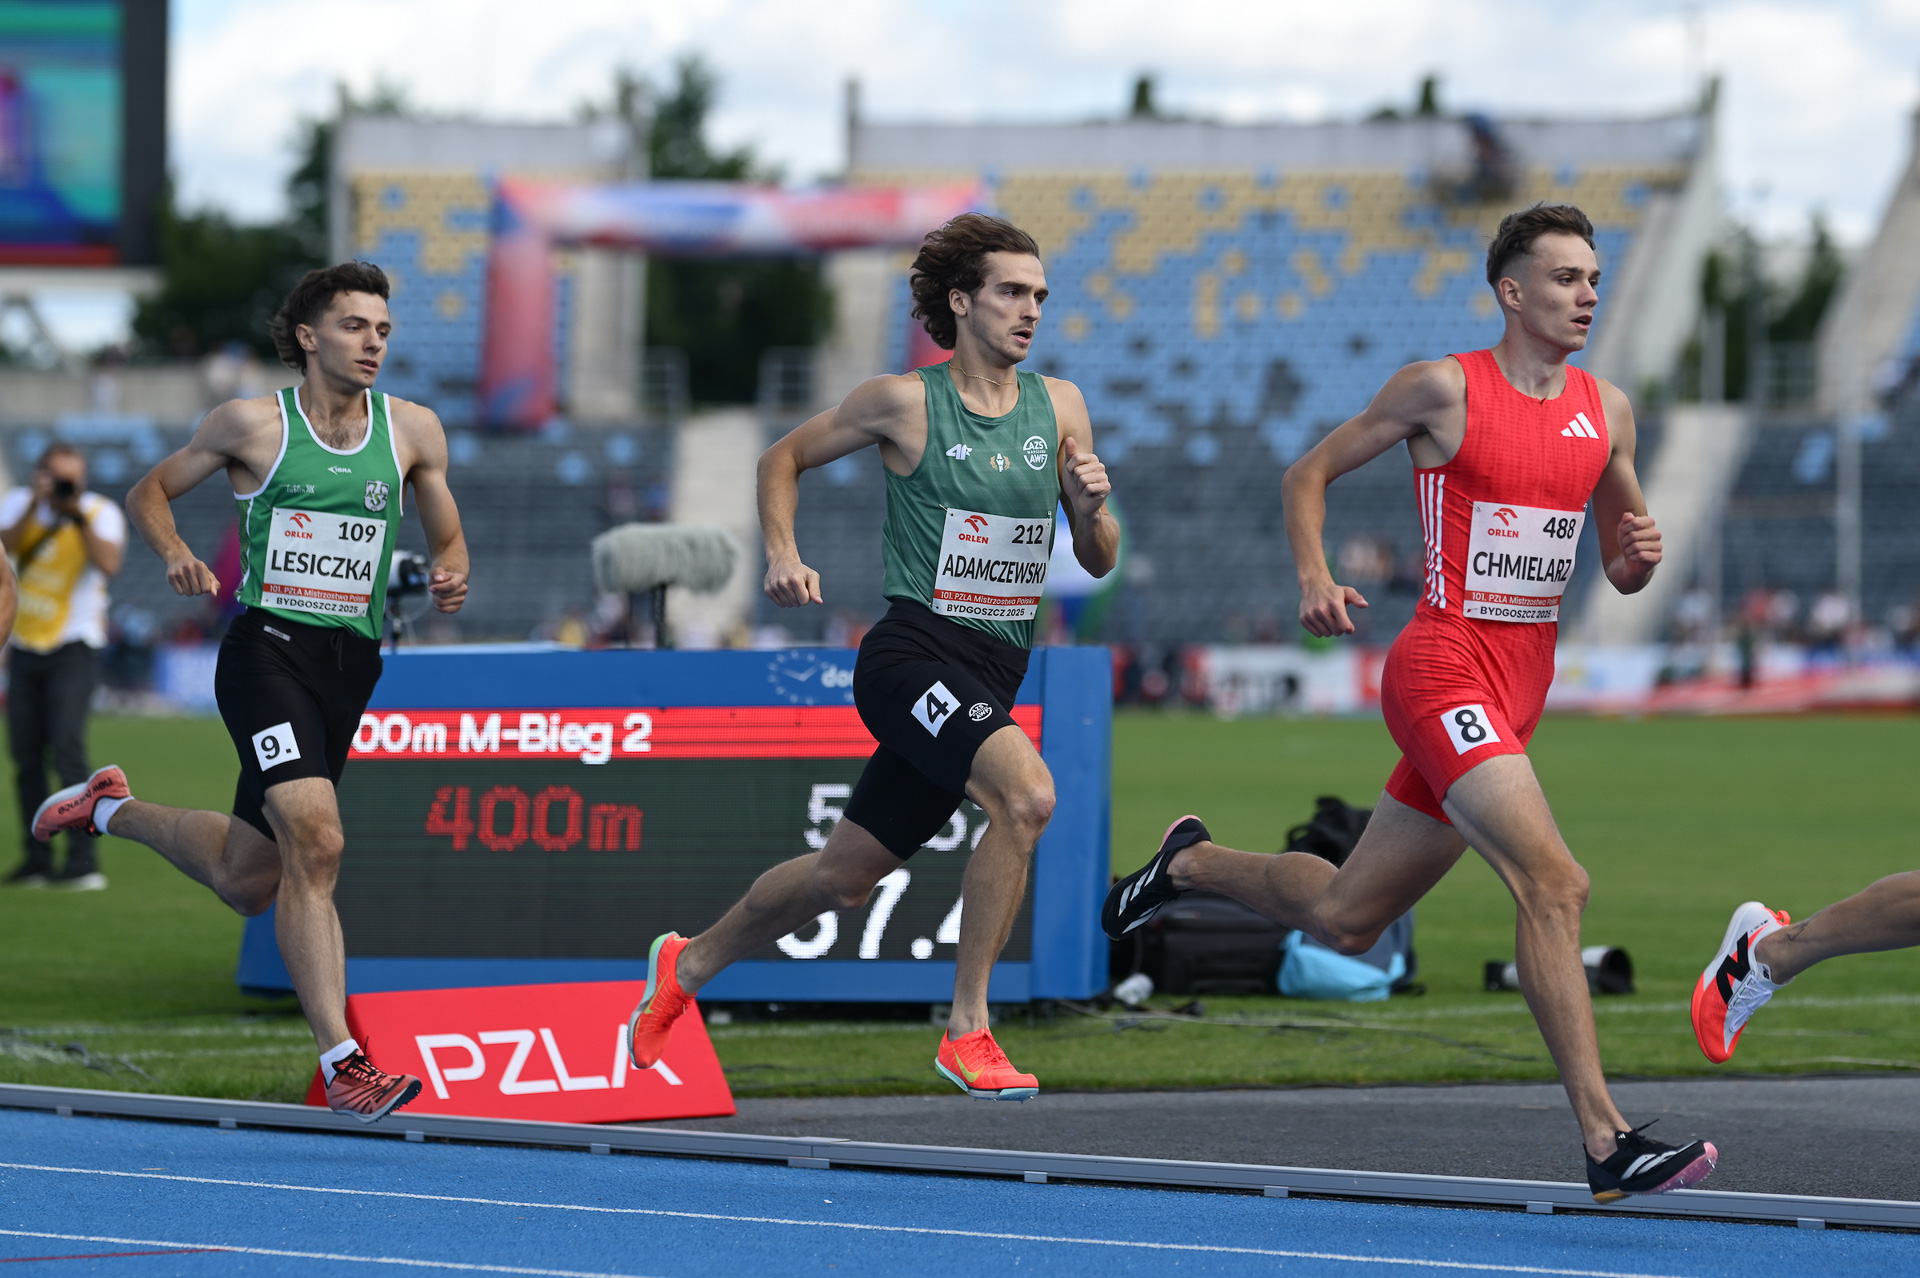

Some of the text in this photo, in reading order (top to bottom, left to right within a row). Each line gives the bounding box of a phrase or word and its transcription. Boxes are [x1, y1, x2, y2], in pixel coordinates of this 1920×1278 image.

[1029, 441, 1044, 450] AZS
[1030, 454, 1045, 463] AWF
[284, 530, 313, 540] ORLEN
[338, 521, 376, 543] 109
[958, 533, 989, 544] ORLEN
[1011, 524, 1044, 545] 212
[1487, 528, 1519, 539] ORLEN
[1543, 517, 1577, 539] 488
[271, 549, 371, 582] LESICZKA
[942, 553, 1047, 584] ADAMCZEWSKI
[1473, 551, 1572, 582] CHMIELARZ
[269, 585, 367, 603] 101. PZLA Mistrzostwa Polski
[940, 591, 1035, 605] 101. PZLA Mistrzostwa Polski
[1472, 592, 1487, 602] 101.
[1488, 594, 1508, 603] PZLA
[1509, 596, 1546, 606] Mistrzostwa
[276, 597, 358, 613] BYDGOSZCZ 2025
[946, 604, 1025, 617] BYDGOSZCZ 2025
[1480, 606, 1552, 618] BYDGOSZCZ 2025
[926, 691, 950, 724] 4
[1455, 709, 1487, 743] 8
[261, 735, 292, 760] 9.
[351, 712, 652, 765] 00m M-Bieg 2
[424, 784, 644, 852] 400m
[415, 1023, 684, 1100] PZLA
